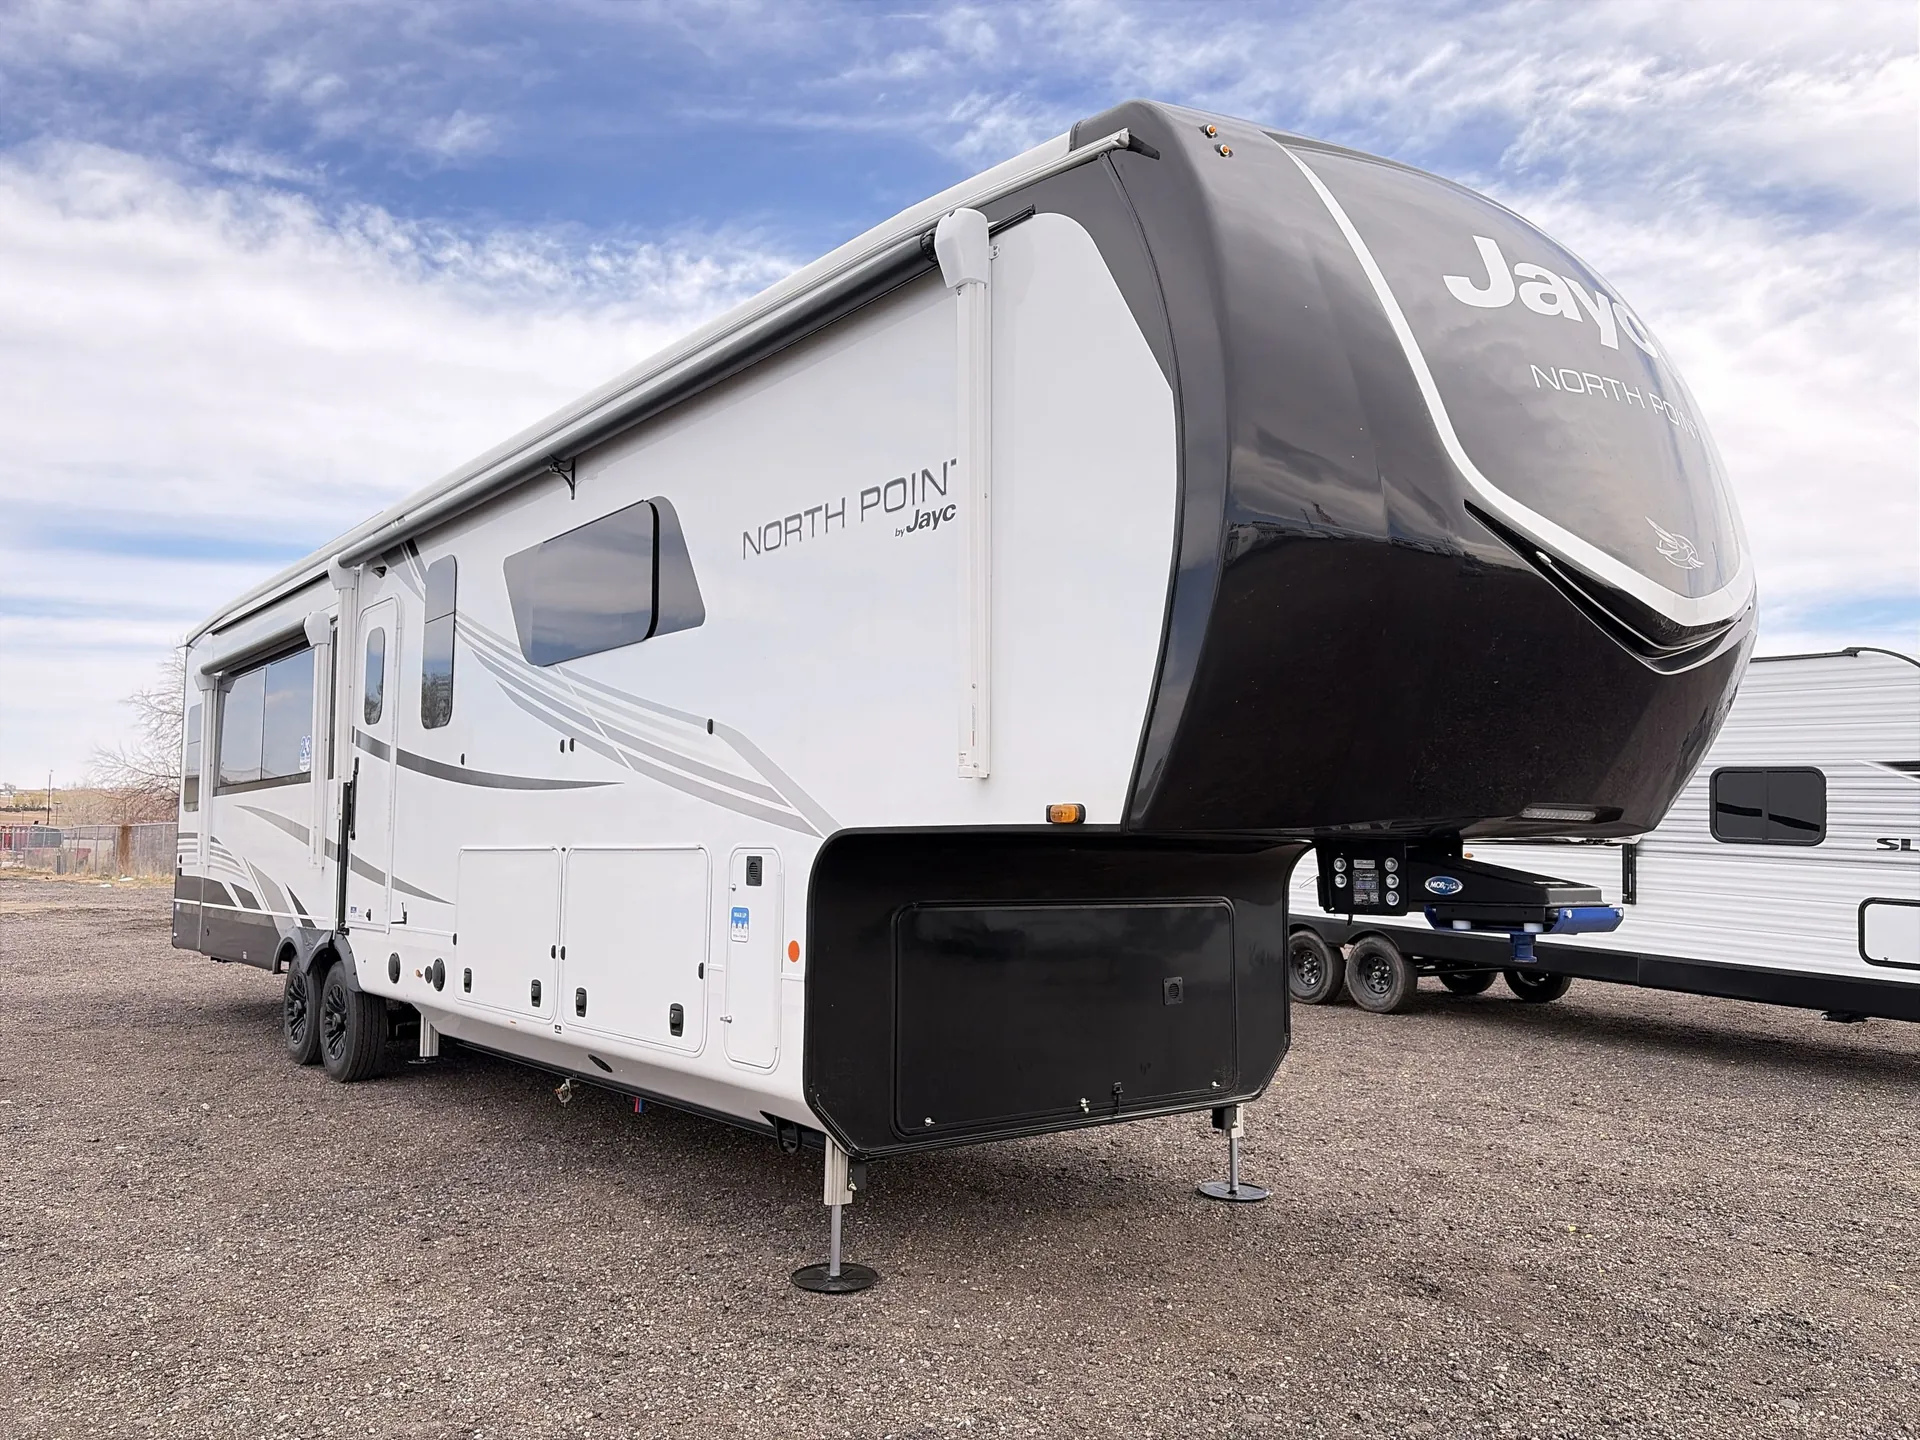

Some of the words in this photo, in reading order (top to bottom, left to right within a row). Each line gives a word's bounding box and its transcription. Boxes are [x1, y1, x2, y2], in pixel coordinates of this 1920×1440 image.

[1530, 364, 1645, 409] NORTH
[742, 496, 846, 560] NORTH
[860, 457, 957, 523] POIN
[894, 527, 906, 538] by
[905, 503, 957, 534] Jayc
[1876, 837, 1919, 851] SL
